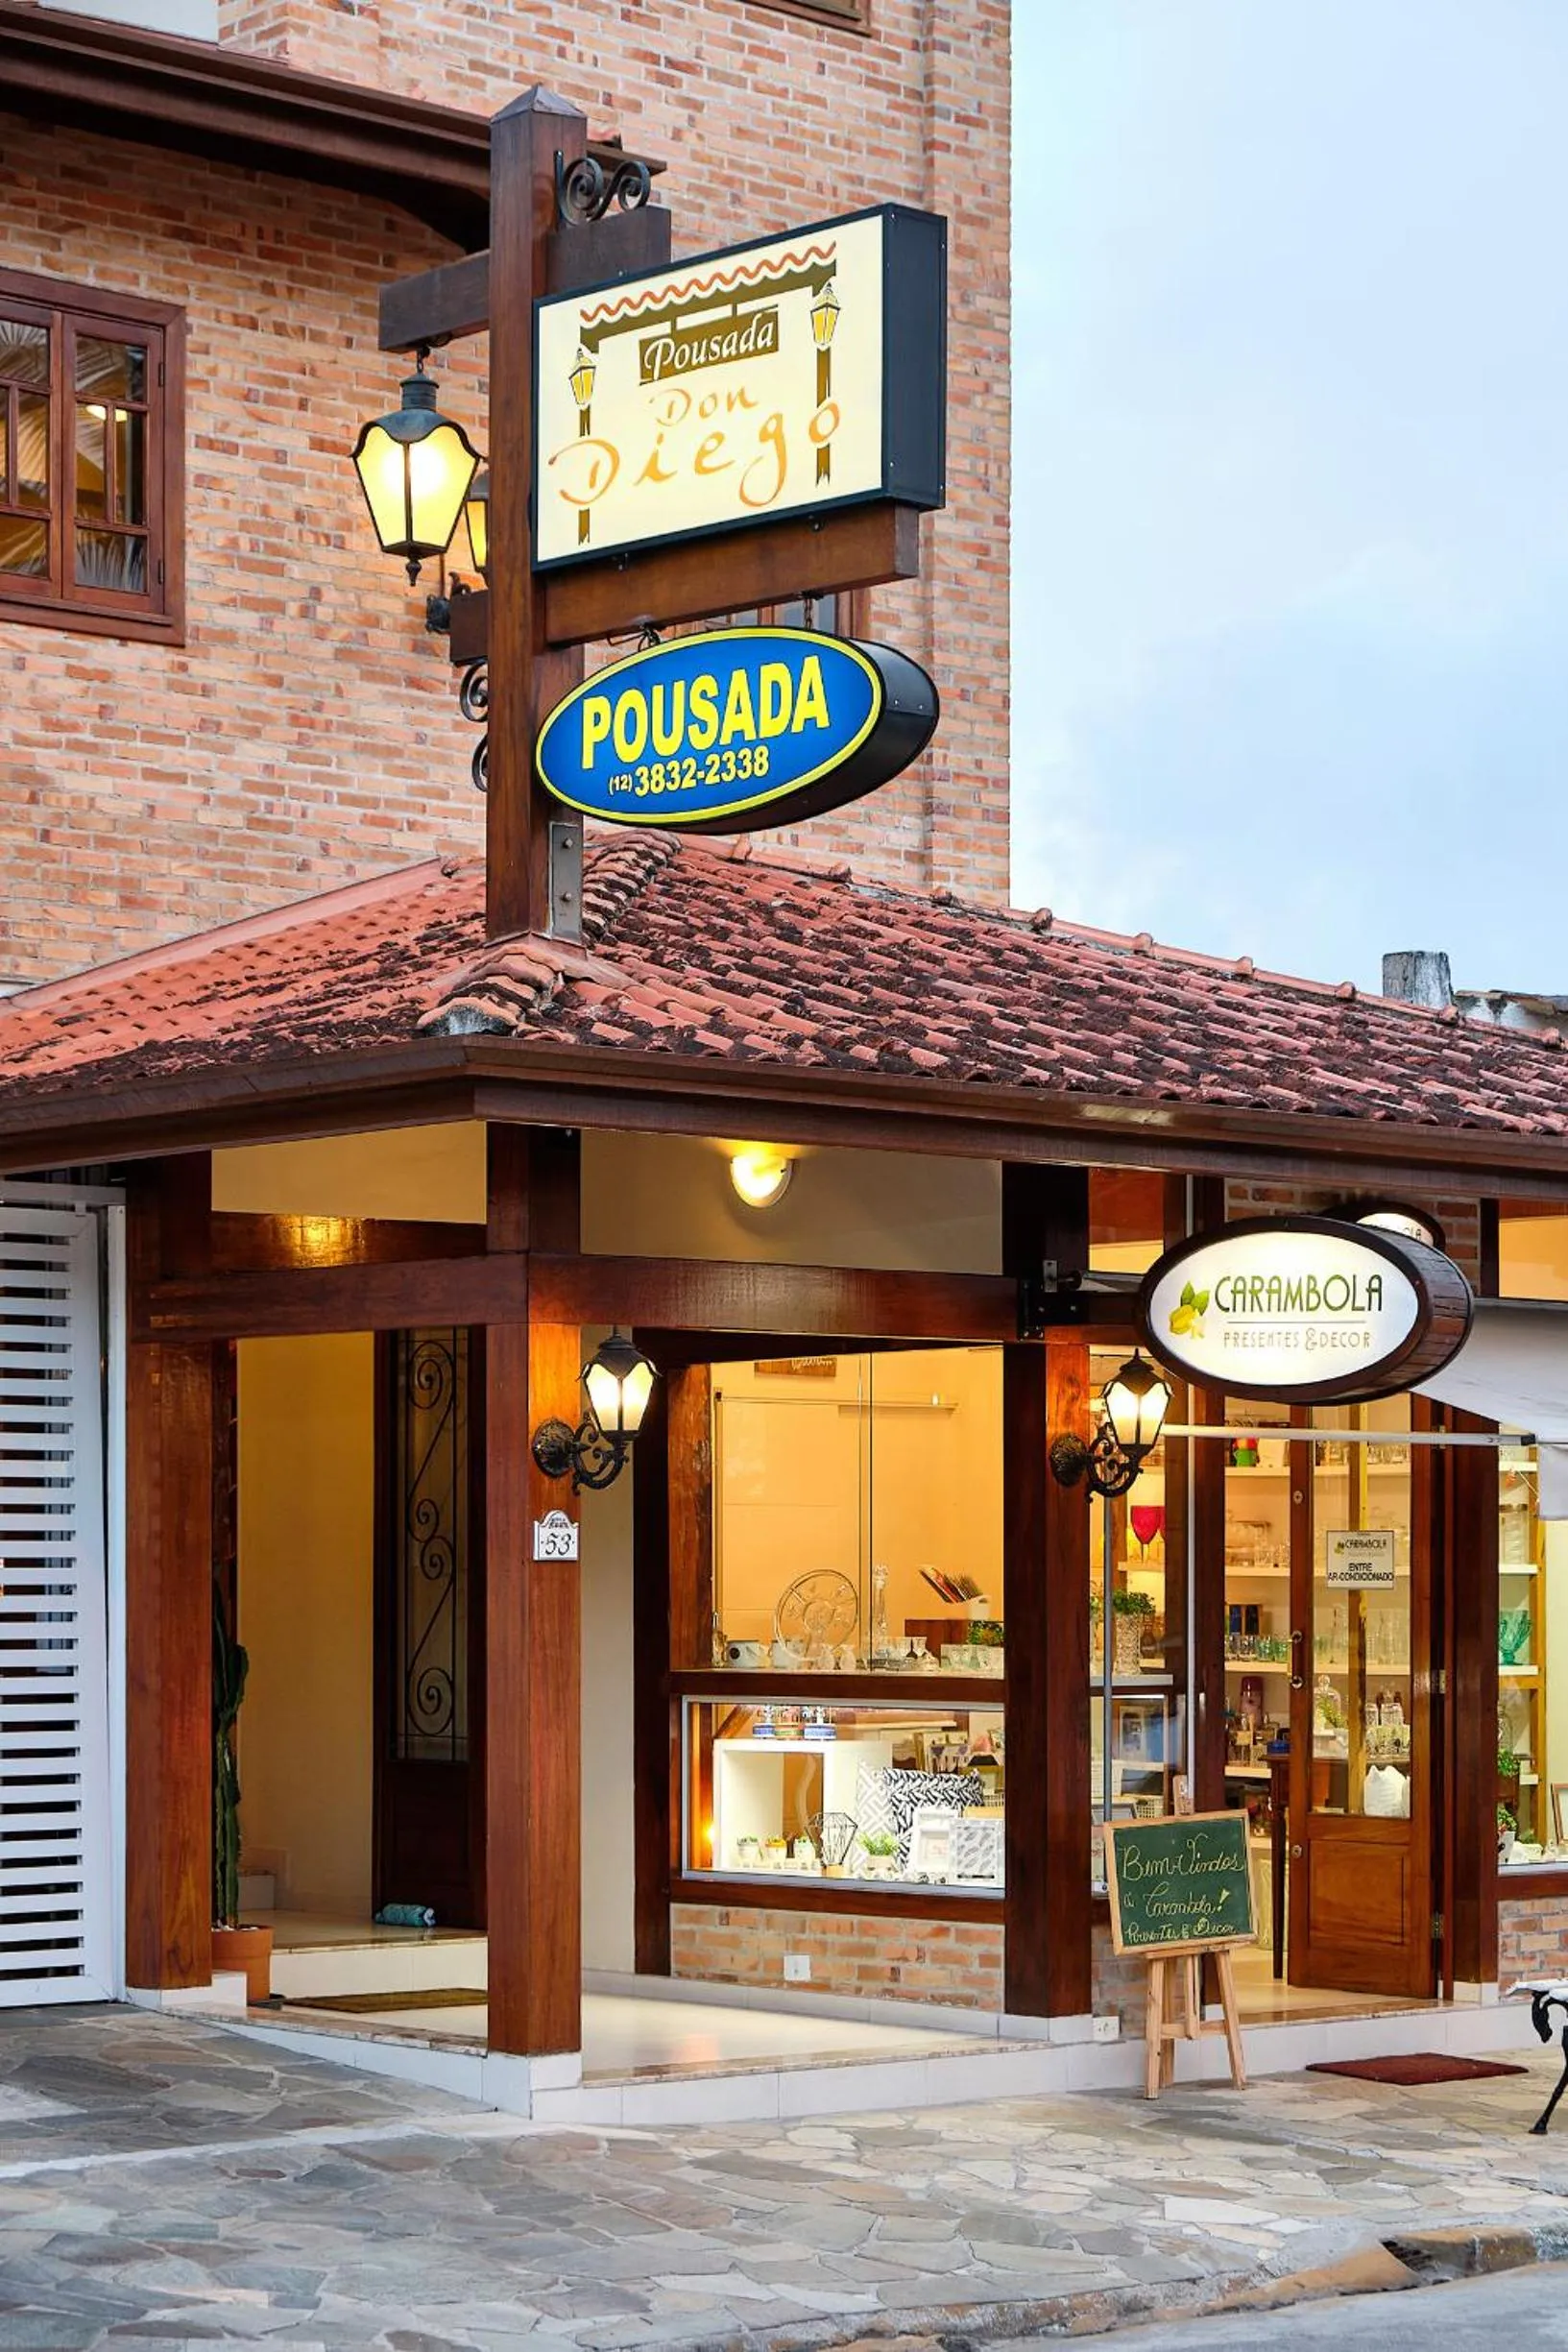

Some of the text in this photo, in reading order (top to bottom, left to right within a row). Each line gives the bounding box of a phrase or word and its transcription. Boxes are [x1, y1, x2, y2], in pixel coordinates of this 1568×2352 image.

[645, 317, 775, 378] Pousada
[650, 386, 759, 426] Don
[548, 401, 841, 508] Diego
[581, 655, 831, 770] POUSADA
[608, 745, 769, 798] (12) 3832-2338
[1215, 1274, 1383, 1313] CARAMBOLA
[1223, 1331, 1300, 1349] PRESENTES
[545, 1533, 572, 1556] 53
[1348, 1562, 1373, 1572] ENTRE
